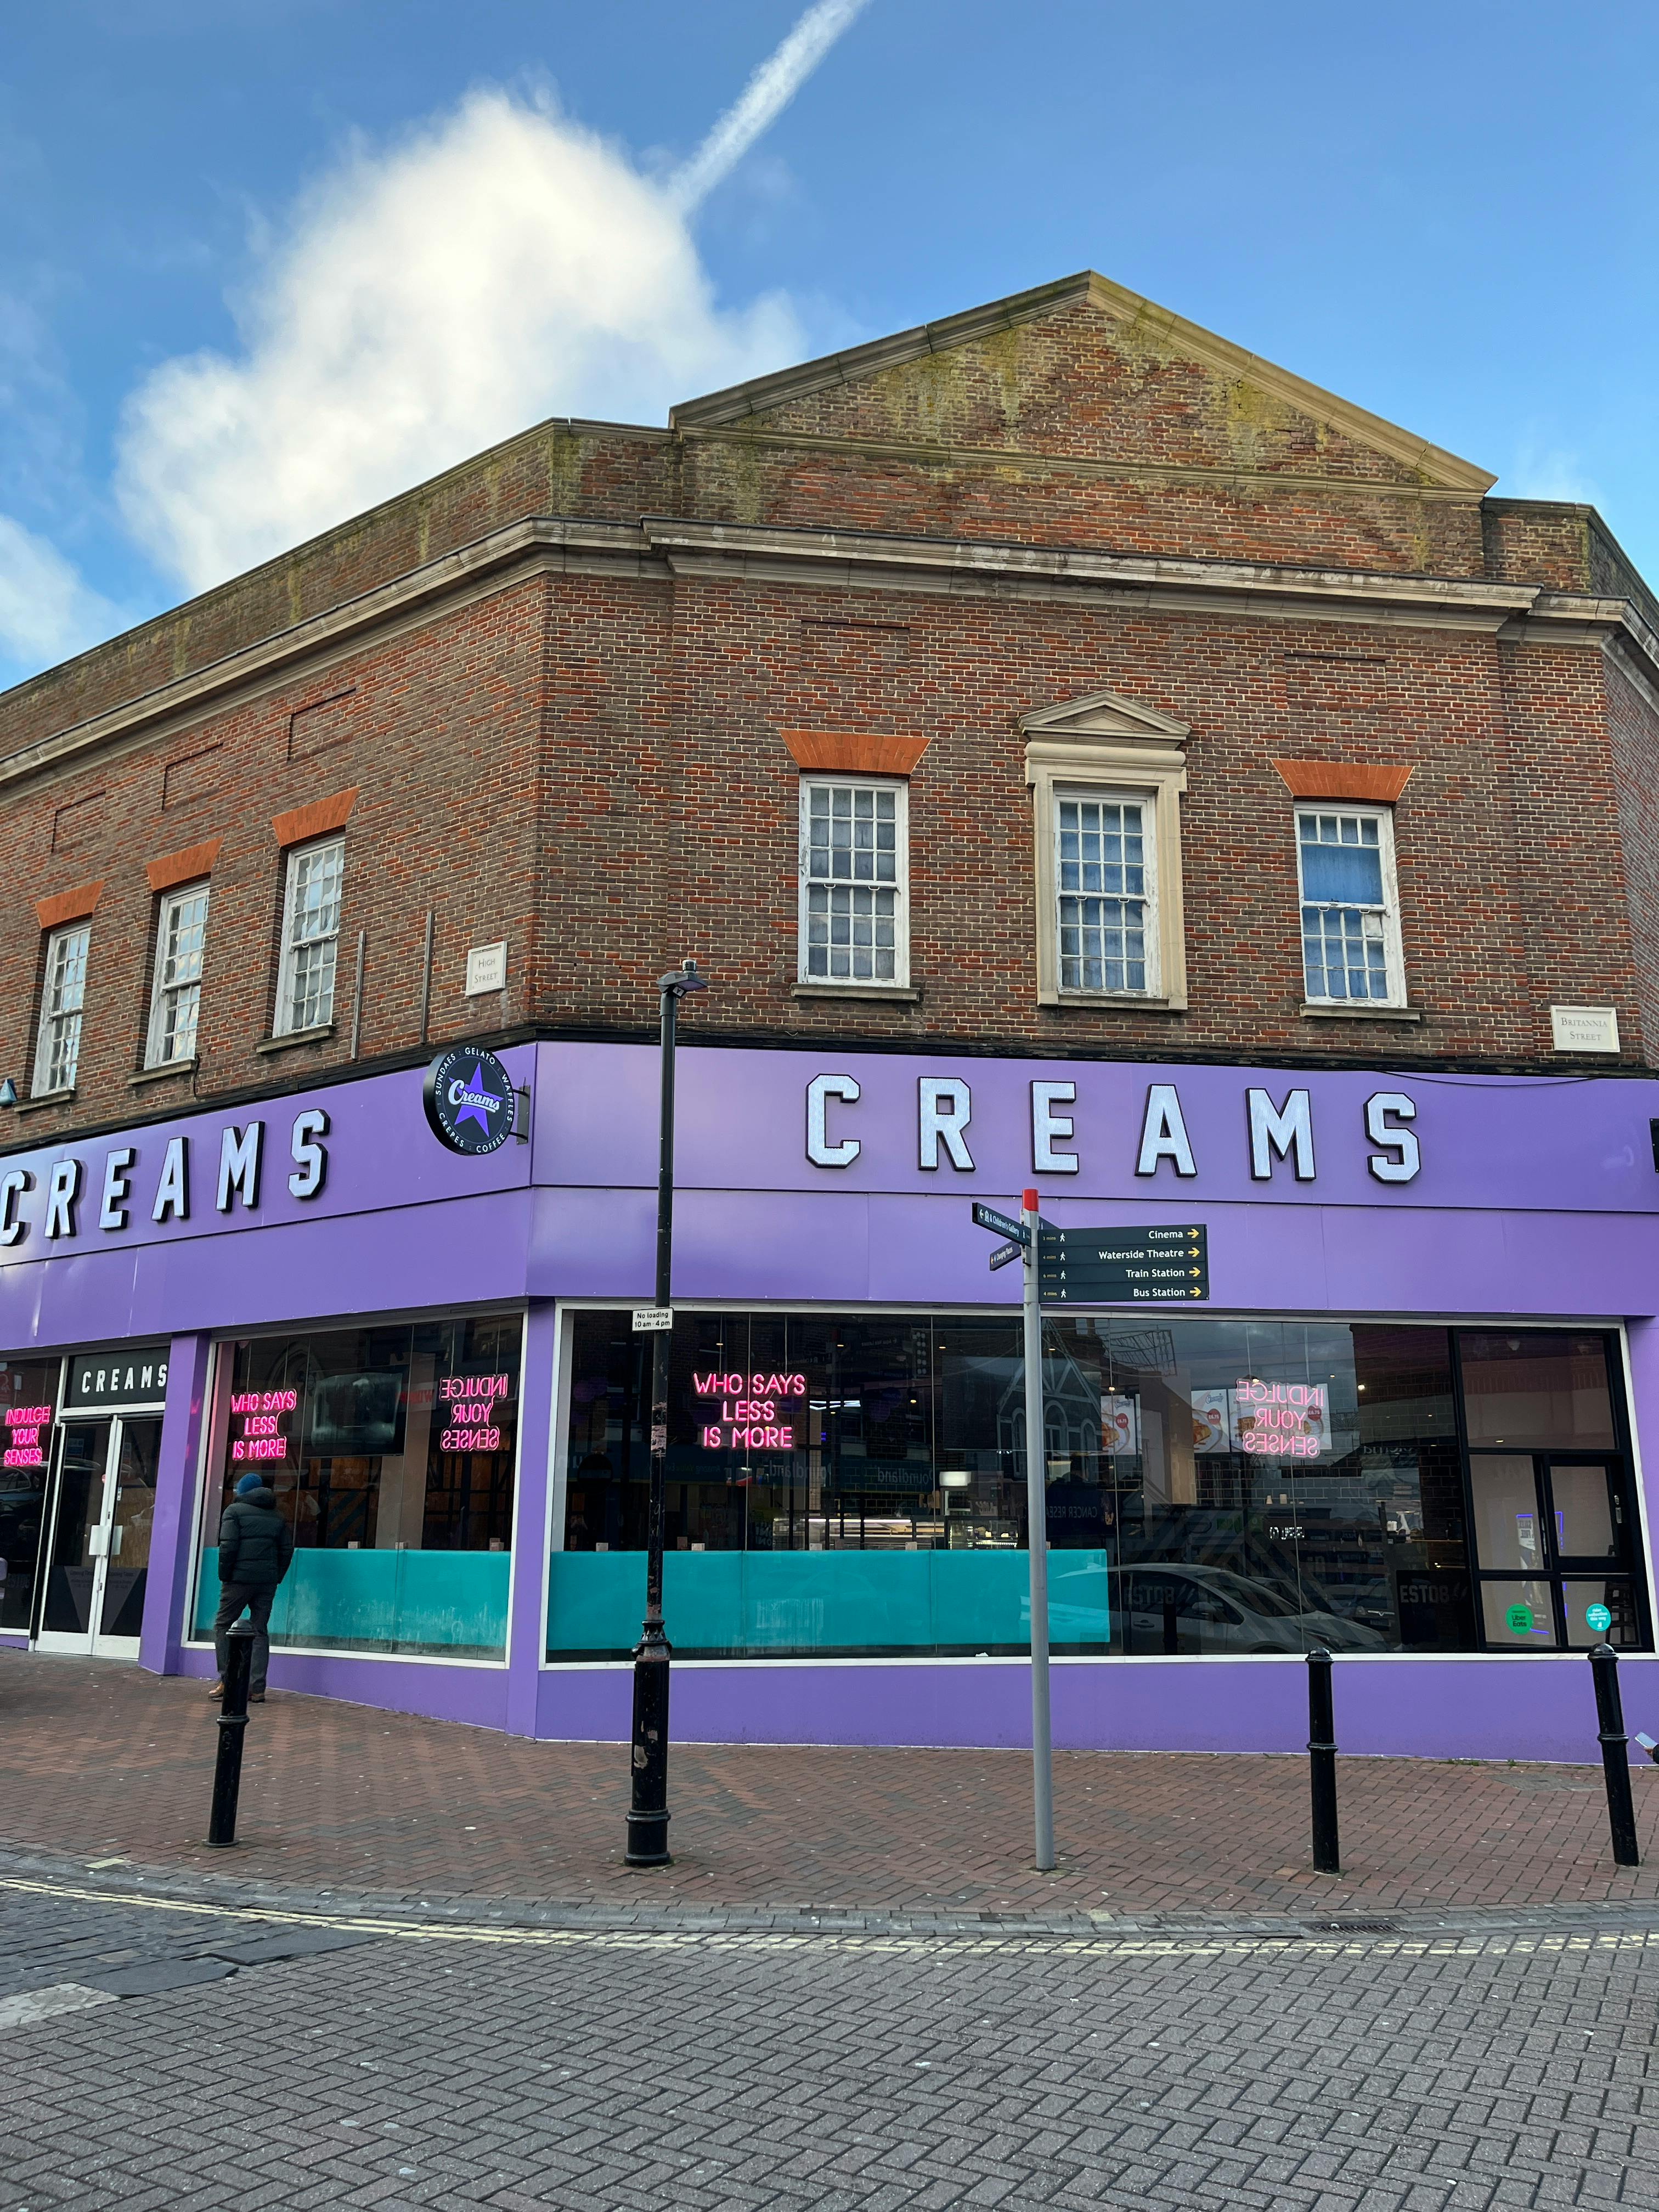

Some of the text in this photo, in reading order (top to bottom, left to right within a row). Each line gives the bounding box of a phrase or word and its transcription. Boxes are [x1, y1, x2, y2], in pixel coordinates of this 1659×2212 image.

[1569, 1031, 1601, 1041] STREET
[465, 1047, 496, 1065] GELATO
[435, 1053, 456, 1096] SUNDAES
[448, 1079, 500, 1111] Creams
[501, 1073, 514, 1122] WAFFLES
[439, 1112, 465, 1148] CREPES
[805, 1073, 1422, 1184] CREAMS
[476, 1133, 505, 1153] COFFEE
[0, 1109, 331, 1246] CREAMS
[1149, 1230, 1183, 1239] Cinema
[1098, 1249, 1184, 1260] Waterside Theatre
[1126, 1268, 1185, 1278] Train Station
[1133, 1288, 1186, 1297] Bus Station
[82, 1364, 167, 1393] CREAMS
[693, 1373, 805, 1395] WHO SAYS
[231, 1390, 296, 1413] WHO SAYS
[723, 1400, 775, 1421] LESS
[5, 1406, 50, 1425] INDULGE
[244, 1415, 275, 1436] LESS
[12, 1428, 38, 1445] YOUR
[703, 1426, 792, 1448] IS MORE
[4, 1447, 42, 1466] SENSES
[233, 1437, 286, 1459] IS MORE
